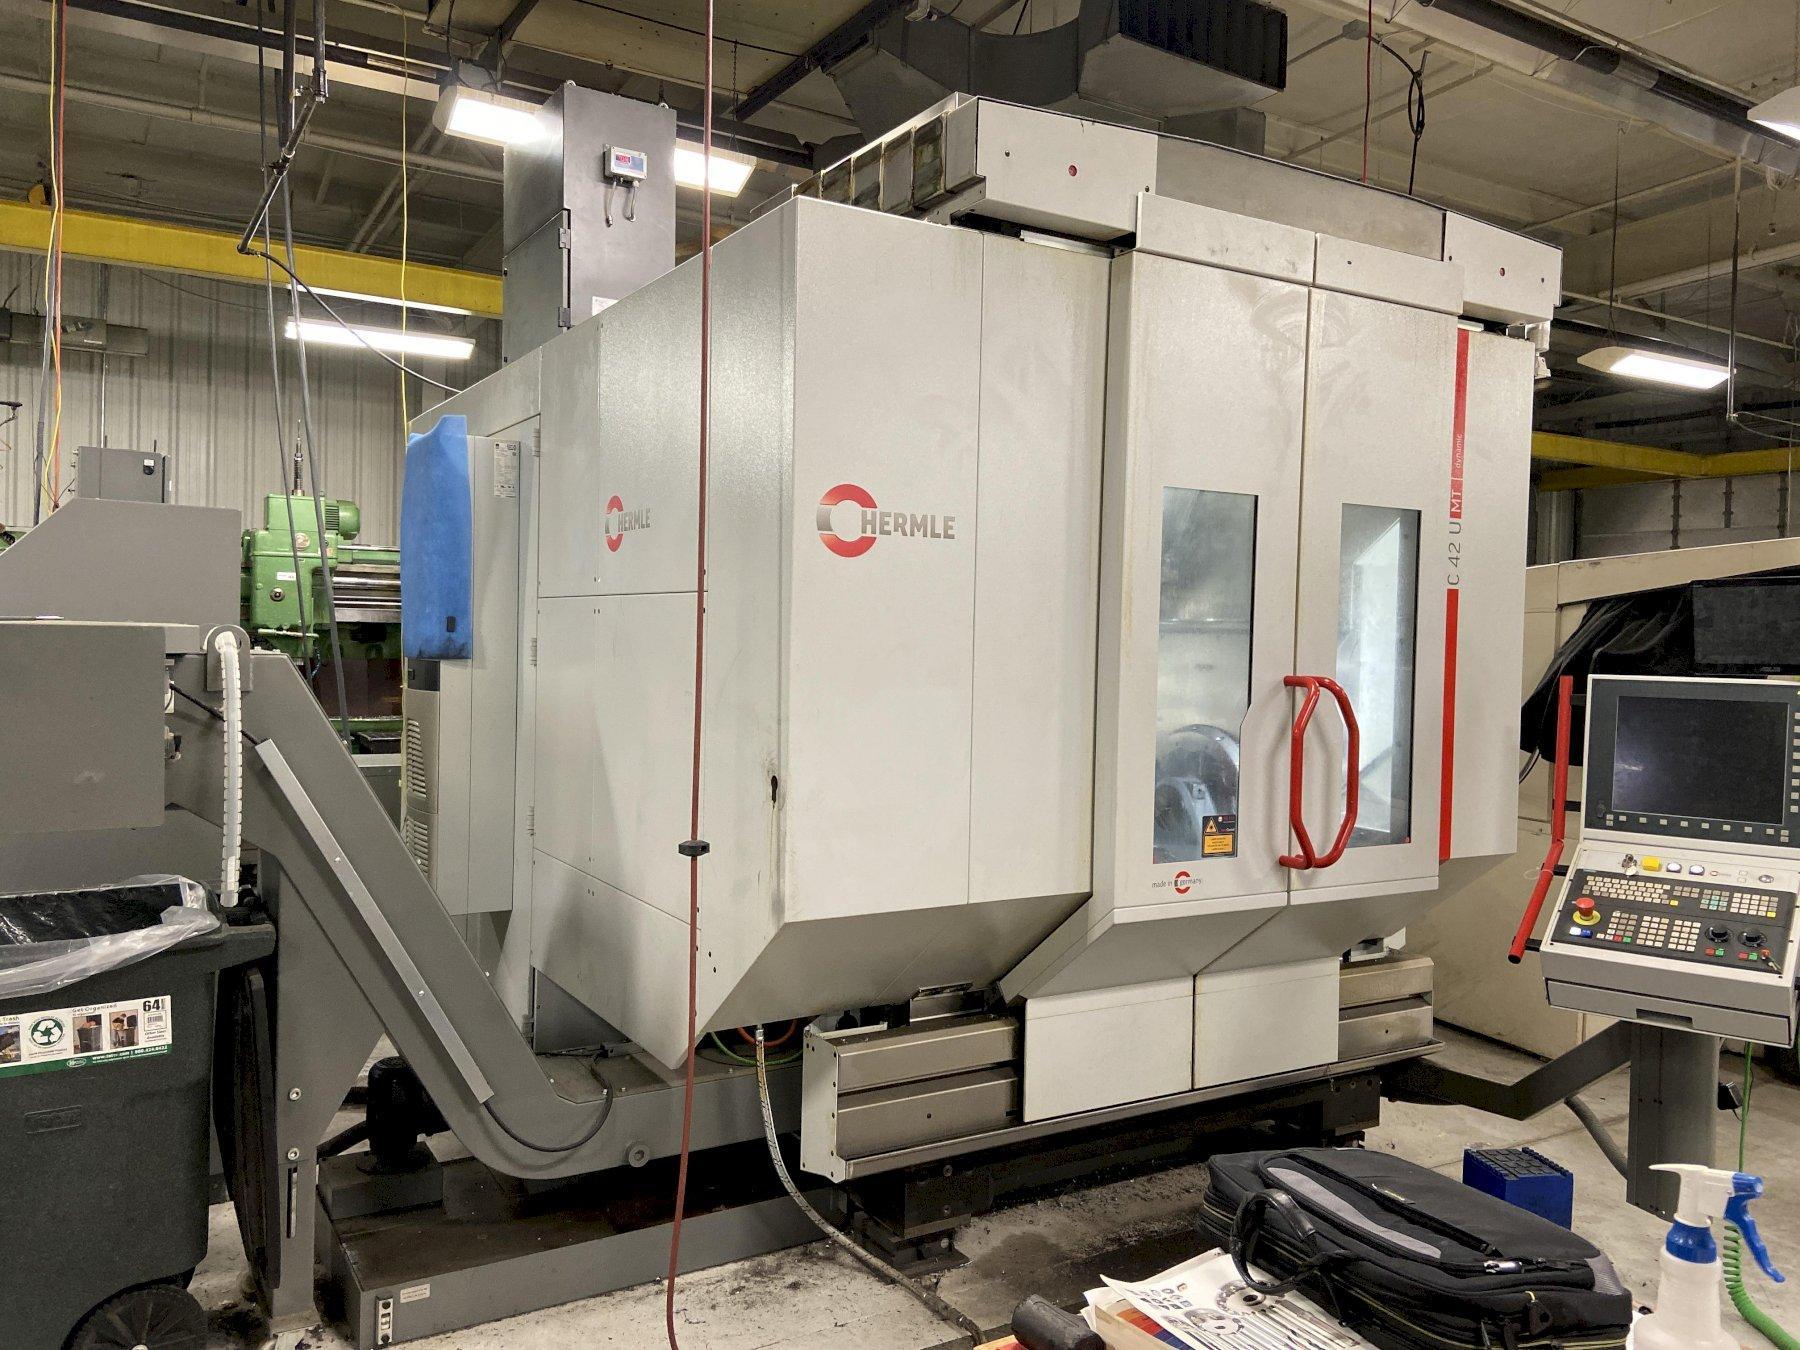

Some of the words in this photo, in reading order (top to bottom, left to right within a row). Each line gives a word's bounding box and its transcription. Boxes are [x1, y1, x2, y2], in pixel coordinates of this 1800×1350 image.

[1454, 433, 1463, 469] dynamic
[1451, 489, 1462, 513] MT
[617, 507, 651, 533] HERMLE
[861, 510, 956, 540] HERMLE
[1449, 521, 1462, 535] U
[1448, 542, 1461, 568] 42
[1447, 574, 1460, 586] C
[1152, 880, 1167, 888] made
[84, 1004, 118, 1013] Organized
[143, 999, 161, 1012] 64
